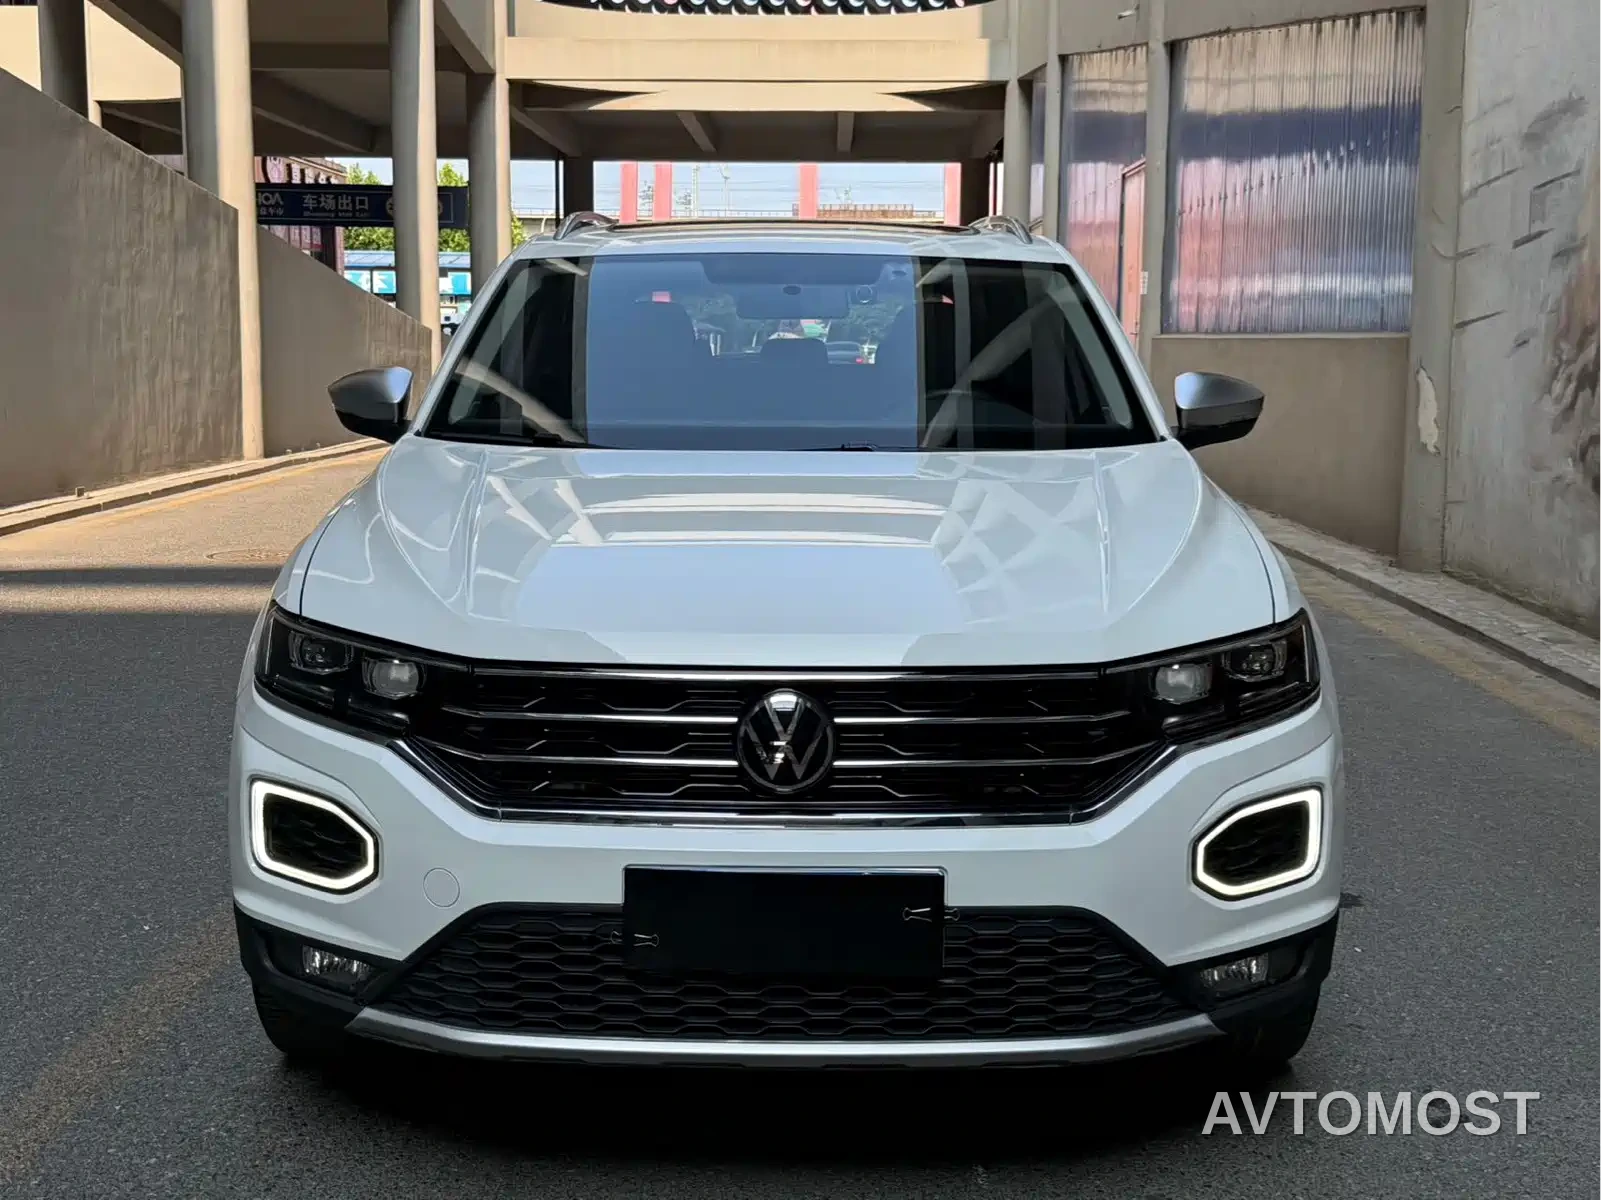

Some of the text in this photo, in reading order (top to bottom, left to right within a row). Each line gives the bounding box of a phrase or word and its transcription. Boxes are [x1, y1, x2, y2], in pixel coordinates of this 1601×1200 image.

[302, 194, 369, 211] 车场出口
[742, 697, 828, 781] VW
